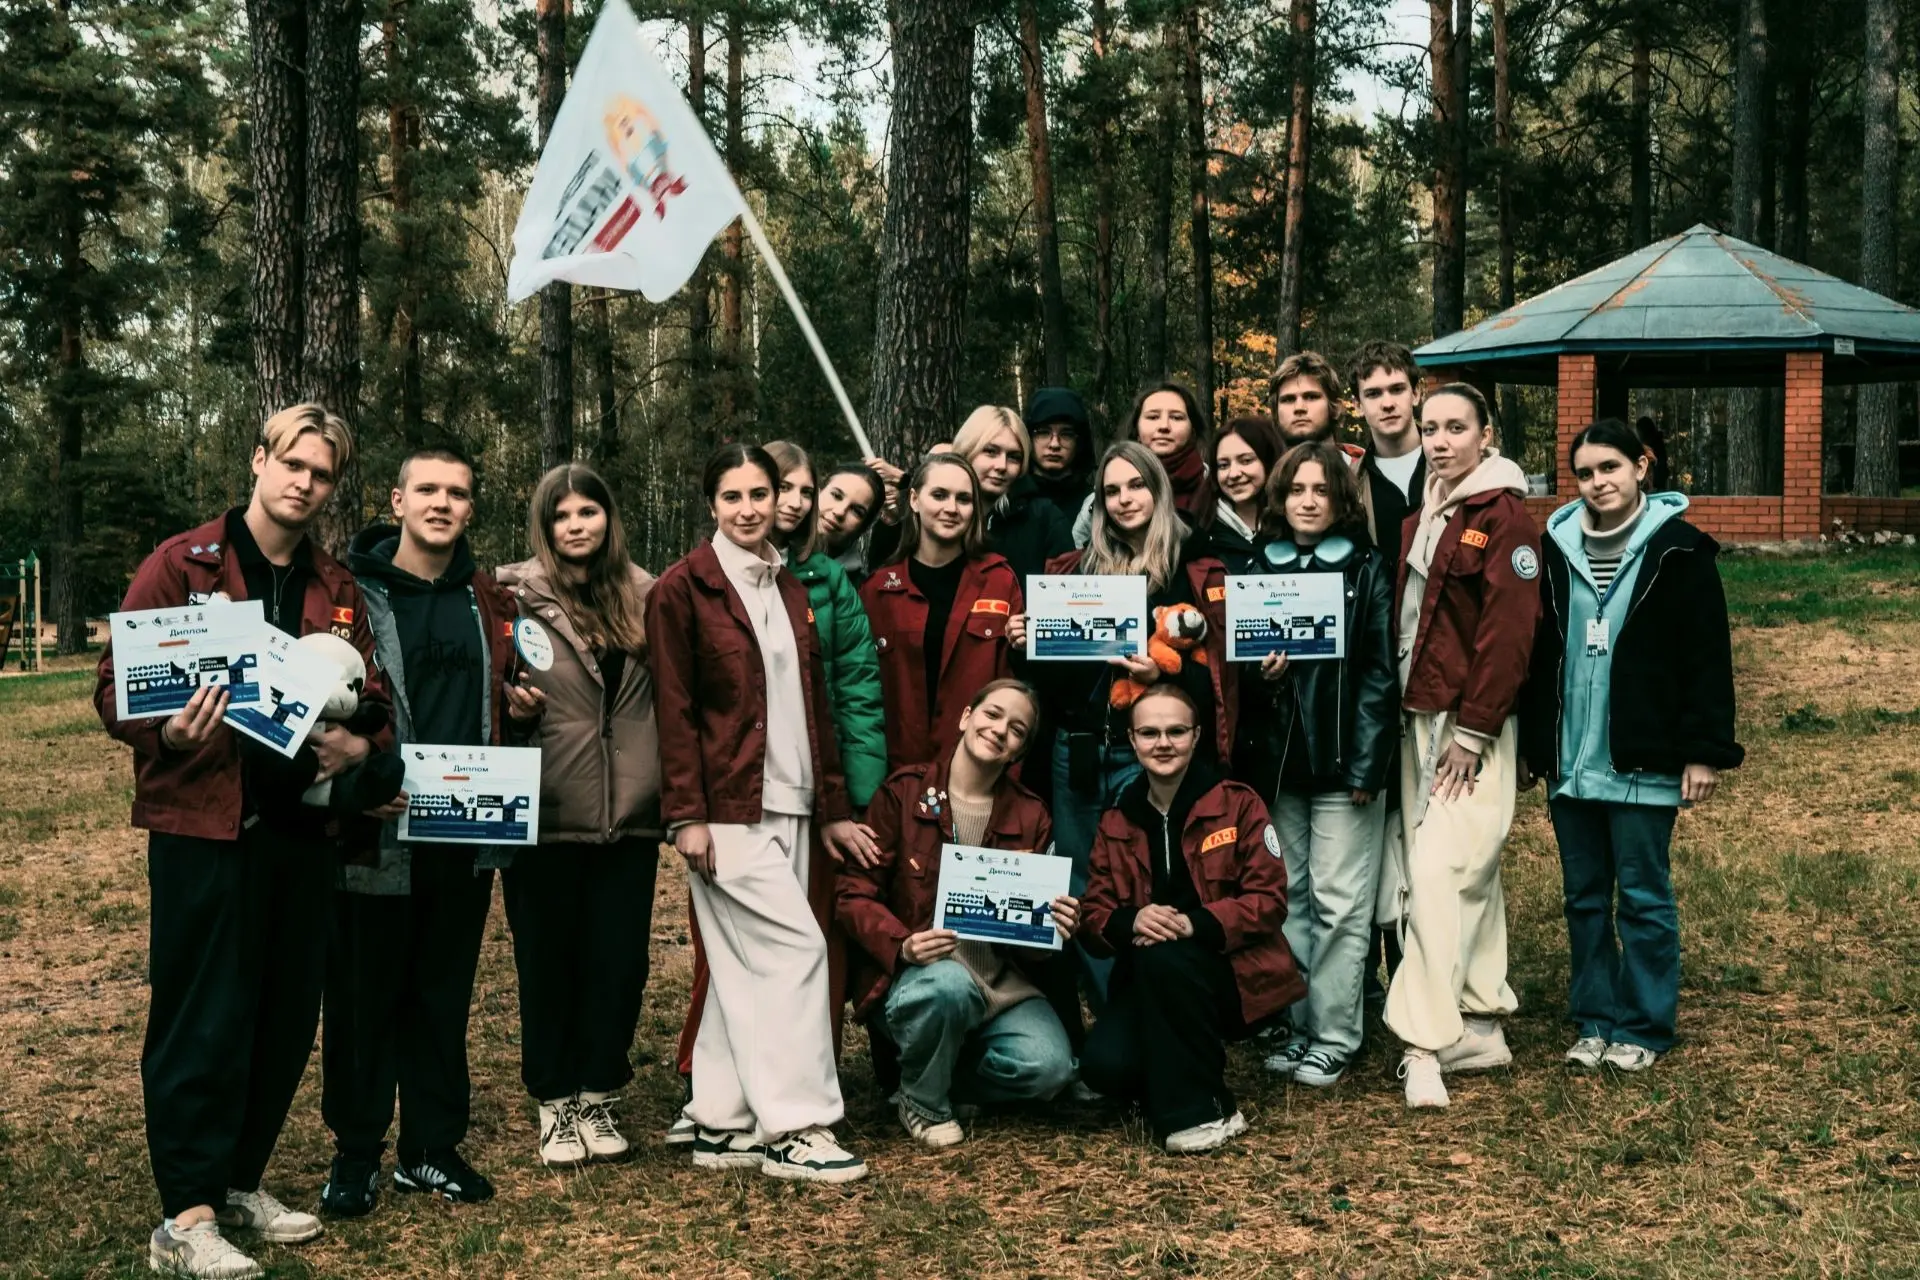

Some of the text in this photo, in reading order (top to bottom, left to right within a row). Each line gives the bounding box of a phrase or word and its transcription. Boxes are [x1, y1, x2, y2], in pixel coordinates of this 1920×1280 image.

[170, 627, 208, 638] Диплом
[453, 765, 489, 773] Диплом
[988, 867, 1022, 877] Диплом
